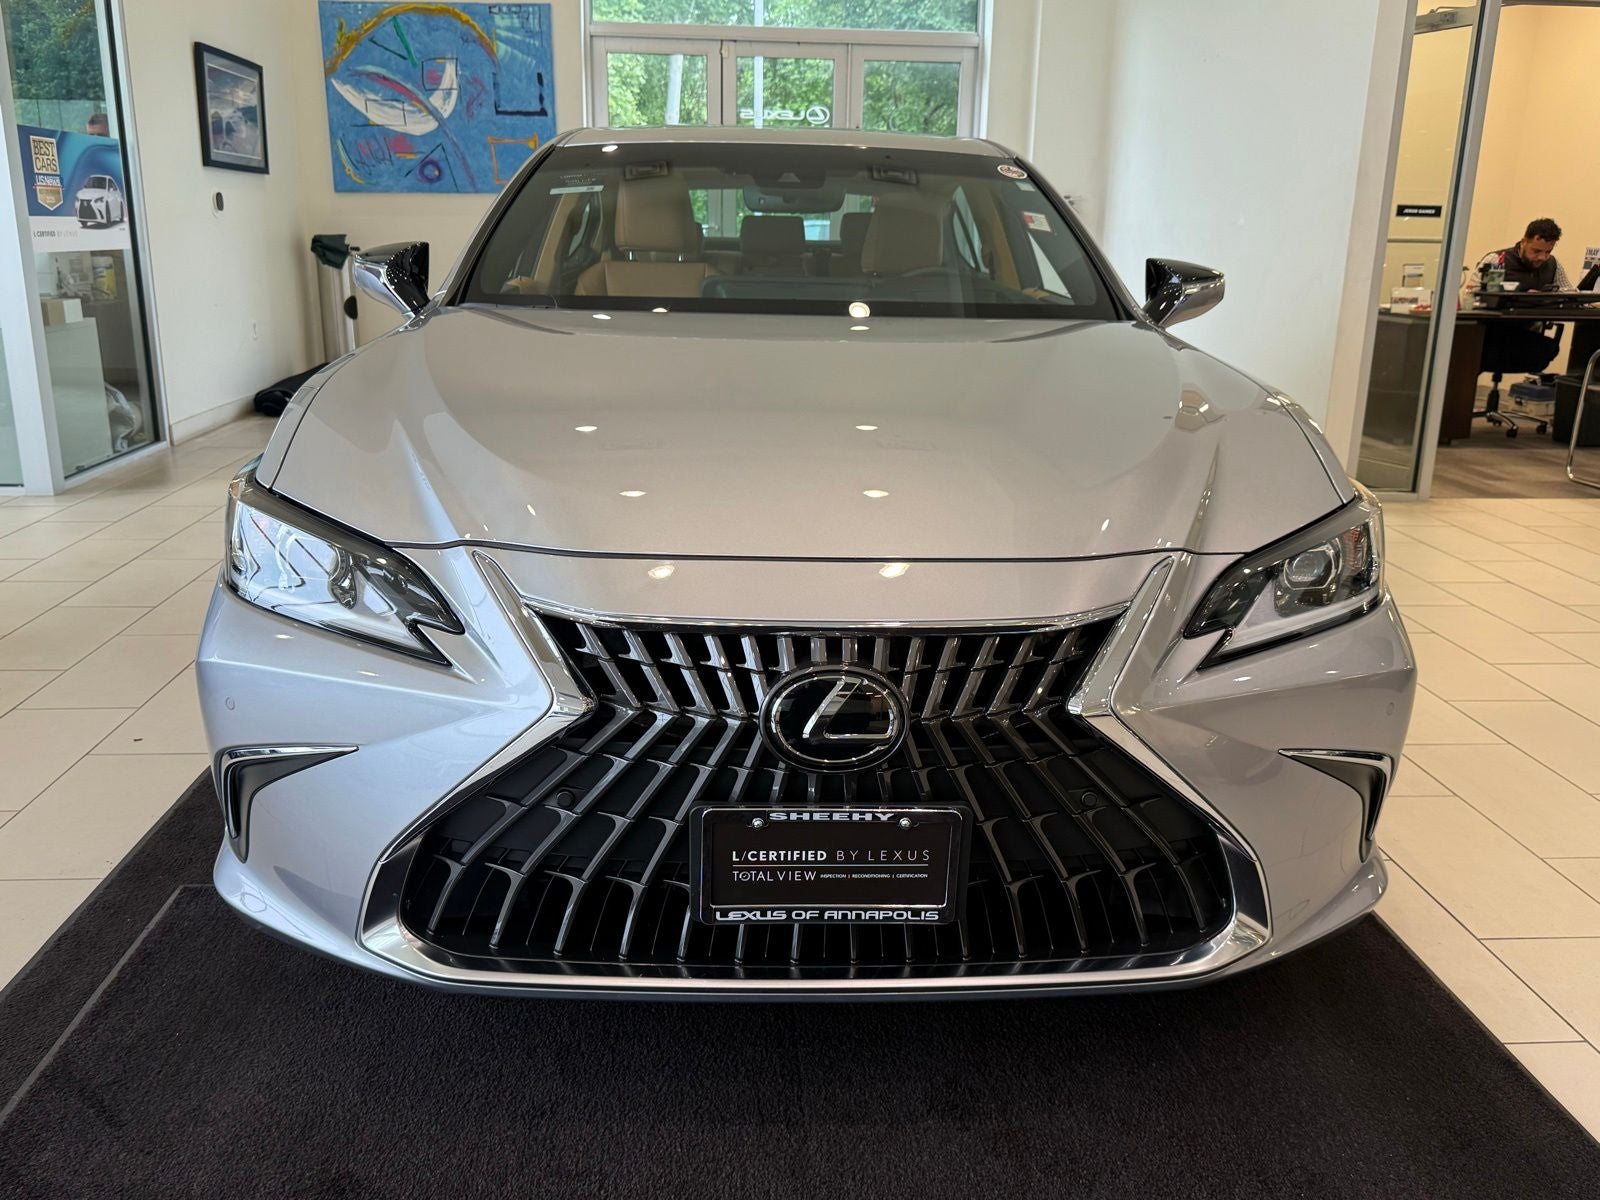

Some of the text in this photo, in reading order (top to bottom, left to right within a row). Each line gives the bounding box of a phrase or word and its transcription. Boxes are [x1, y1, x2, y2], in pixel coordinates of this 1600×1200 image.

[32, 140, 55, 157] BEST
[34, 156, 58, 172] CARS
[769, 812, 895, 821] SHEEHY
[732, 850, 930, 861] L/CERTIFIED BY LEXUS
[715, 910, 939, 921] LEXUS OF ANNAPOLIS
